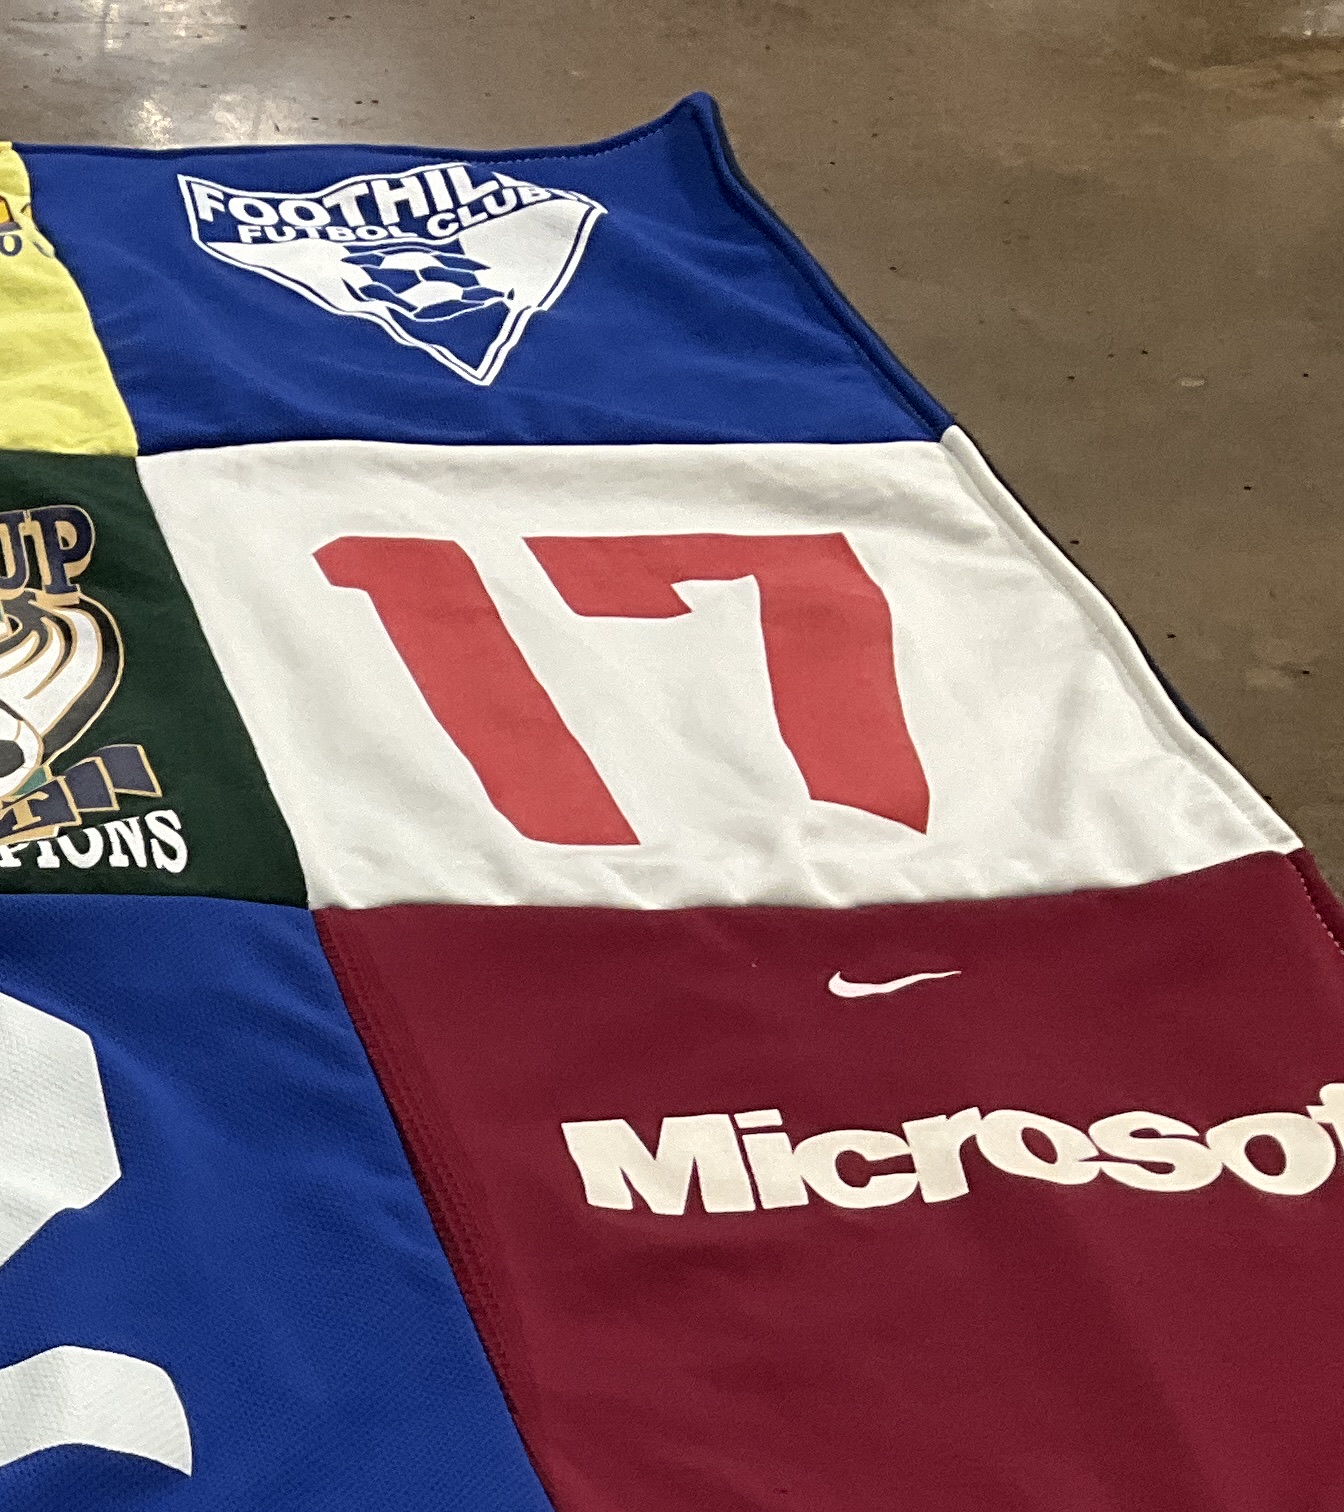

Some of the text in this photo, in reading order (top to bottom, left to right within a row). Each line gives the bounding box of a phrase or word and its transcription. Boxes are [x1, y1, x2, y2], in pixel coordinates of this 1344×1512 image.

[238, 186, 552, 244] FUTBOL CLUB
[313, 532, 930, 846] 17
